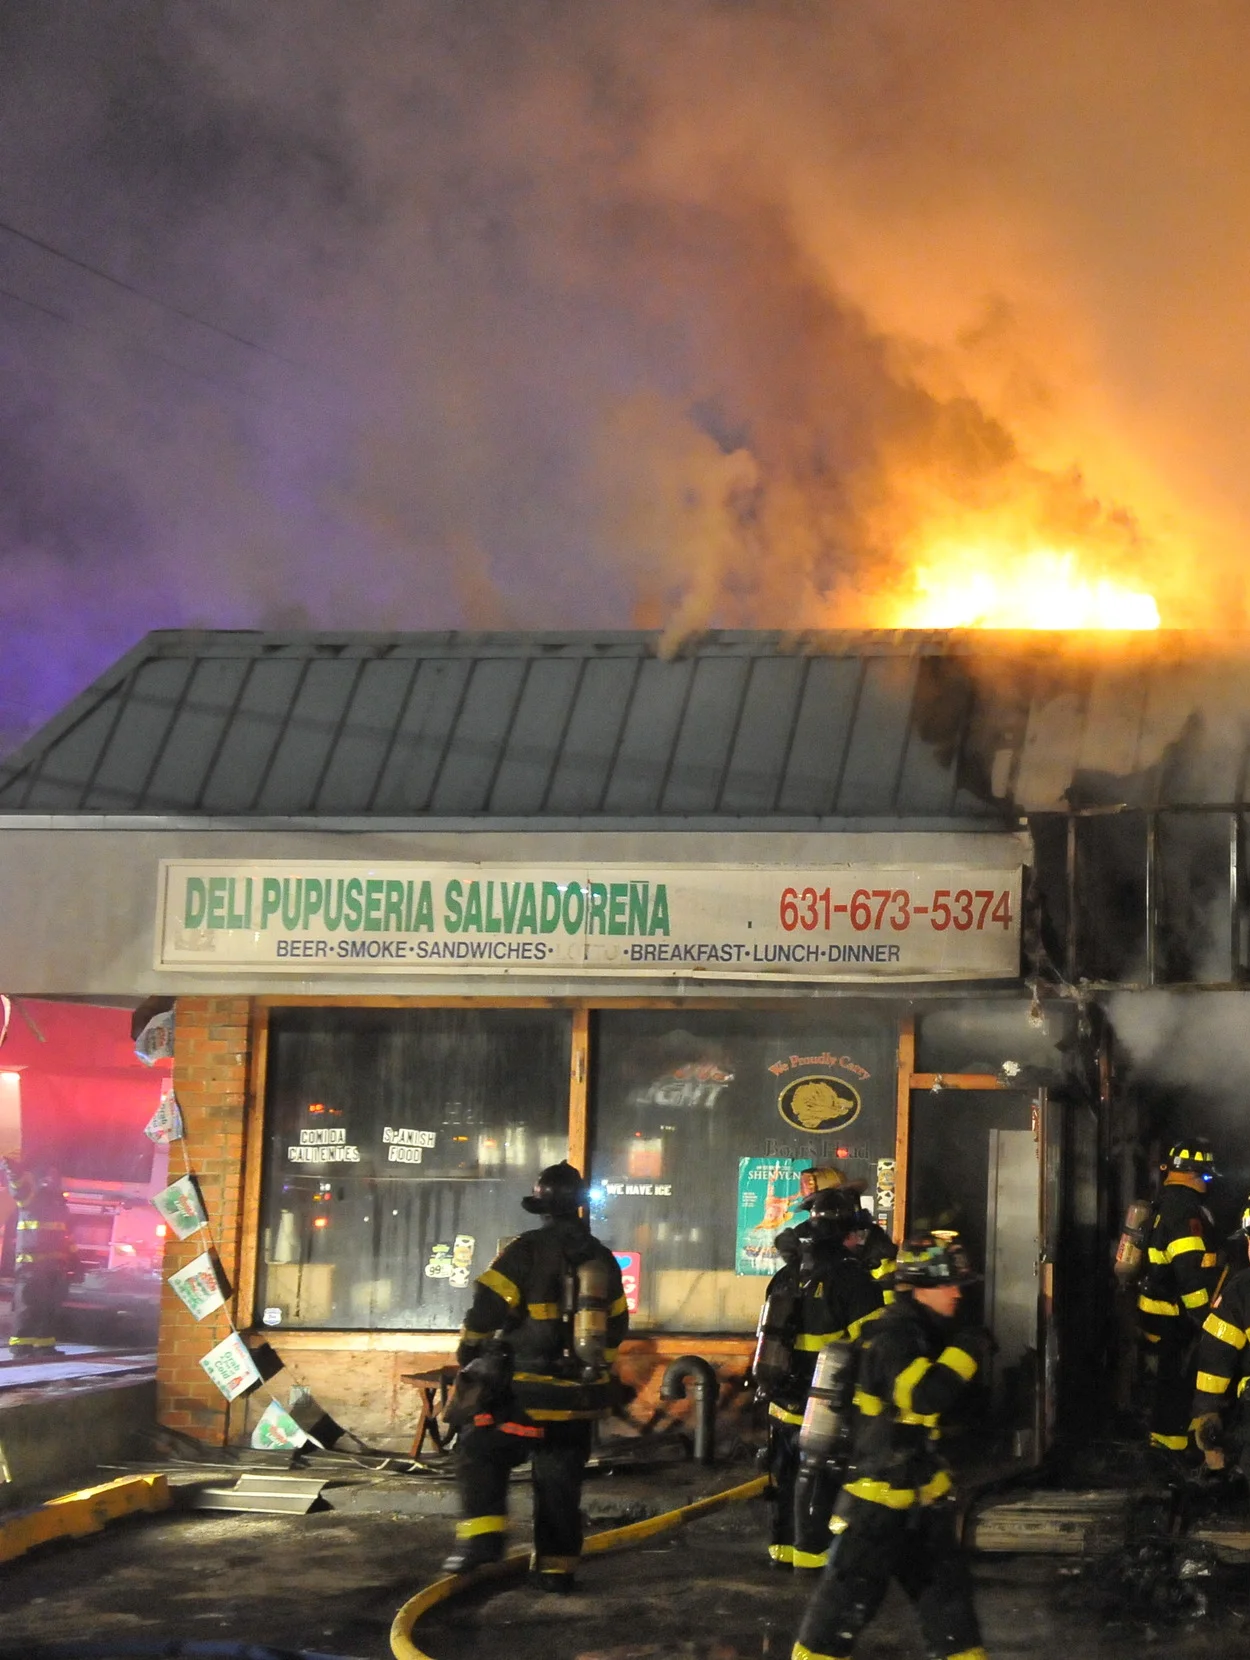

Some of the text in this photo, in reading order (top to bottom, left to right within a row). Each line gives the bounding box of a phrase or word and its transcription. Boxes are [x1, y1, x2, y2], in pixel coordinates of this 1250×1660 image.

[185, 877, 671, 937] DELI PUPUSERIA SALVADOREÑA
[779, 887, 1013, 931] 631-673-5374
[789, 1052, 837, 1068] Proudly
[301, 1130, 346, 1144] COMIDA
[383, 1128, 435, 1147] SPANISH
[289, 1147, 359, 1161] CALIENTES
[389, 1147, 421, 1163] FOOD
[606, 1184, 672, 1196] WE HAVE ICE
